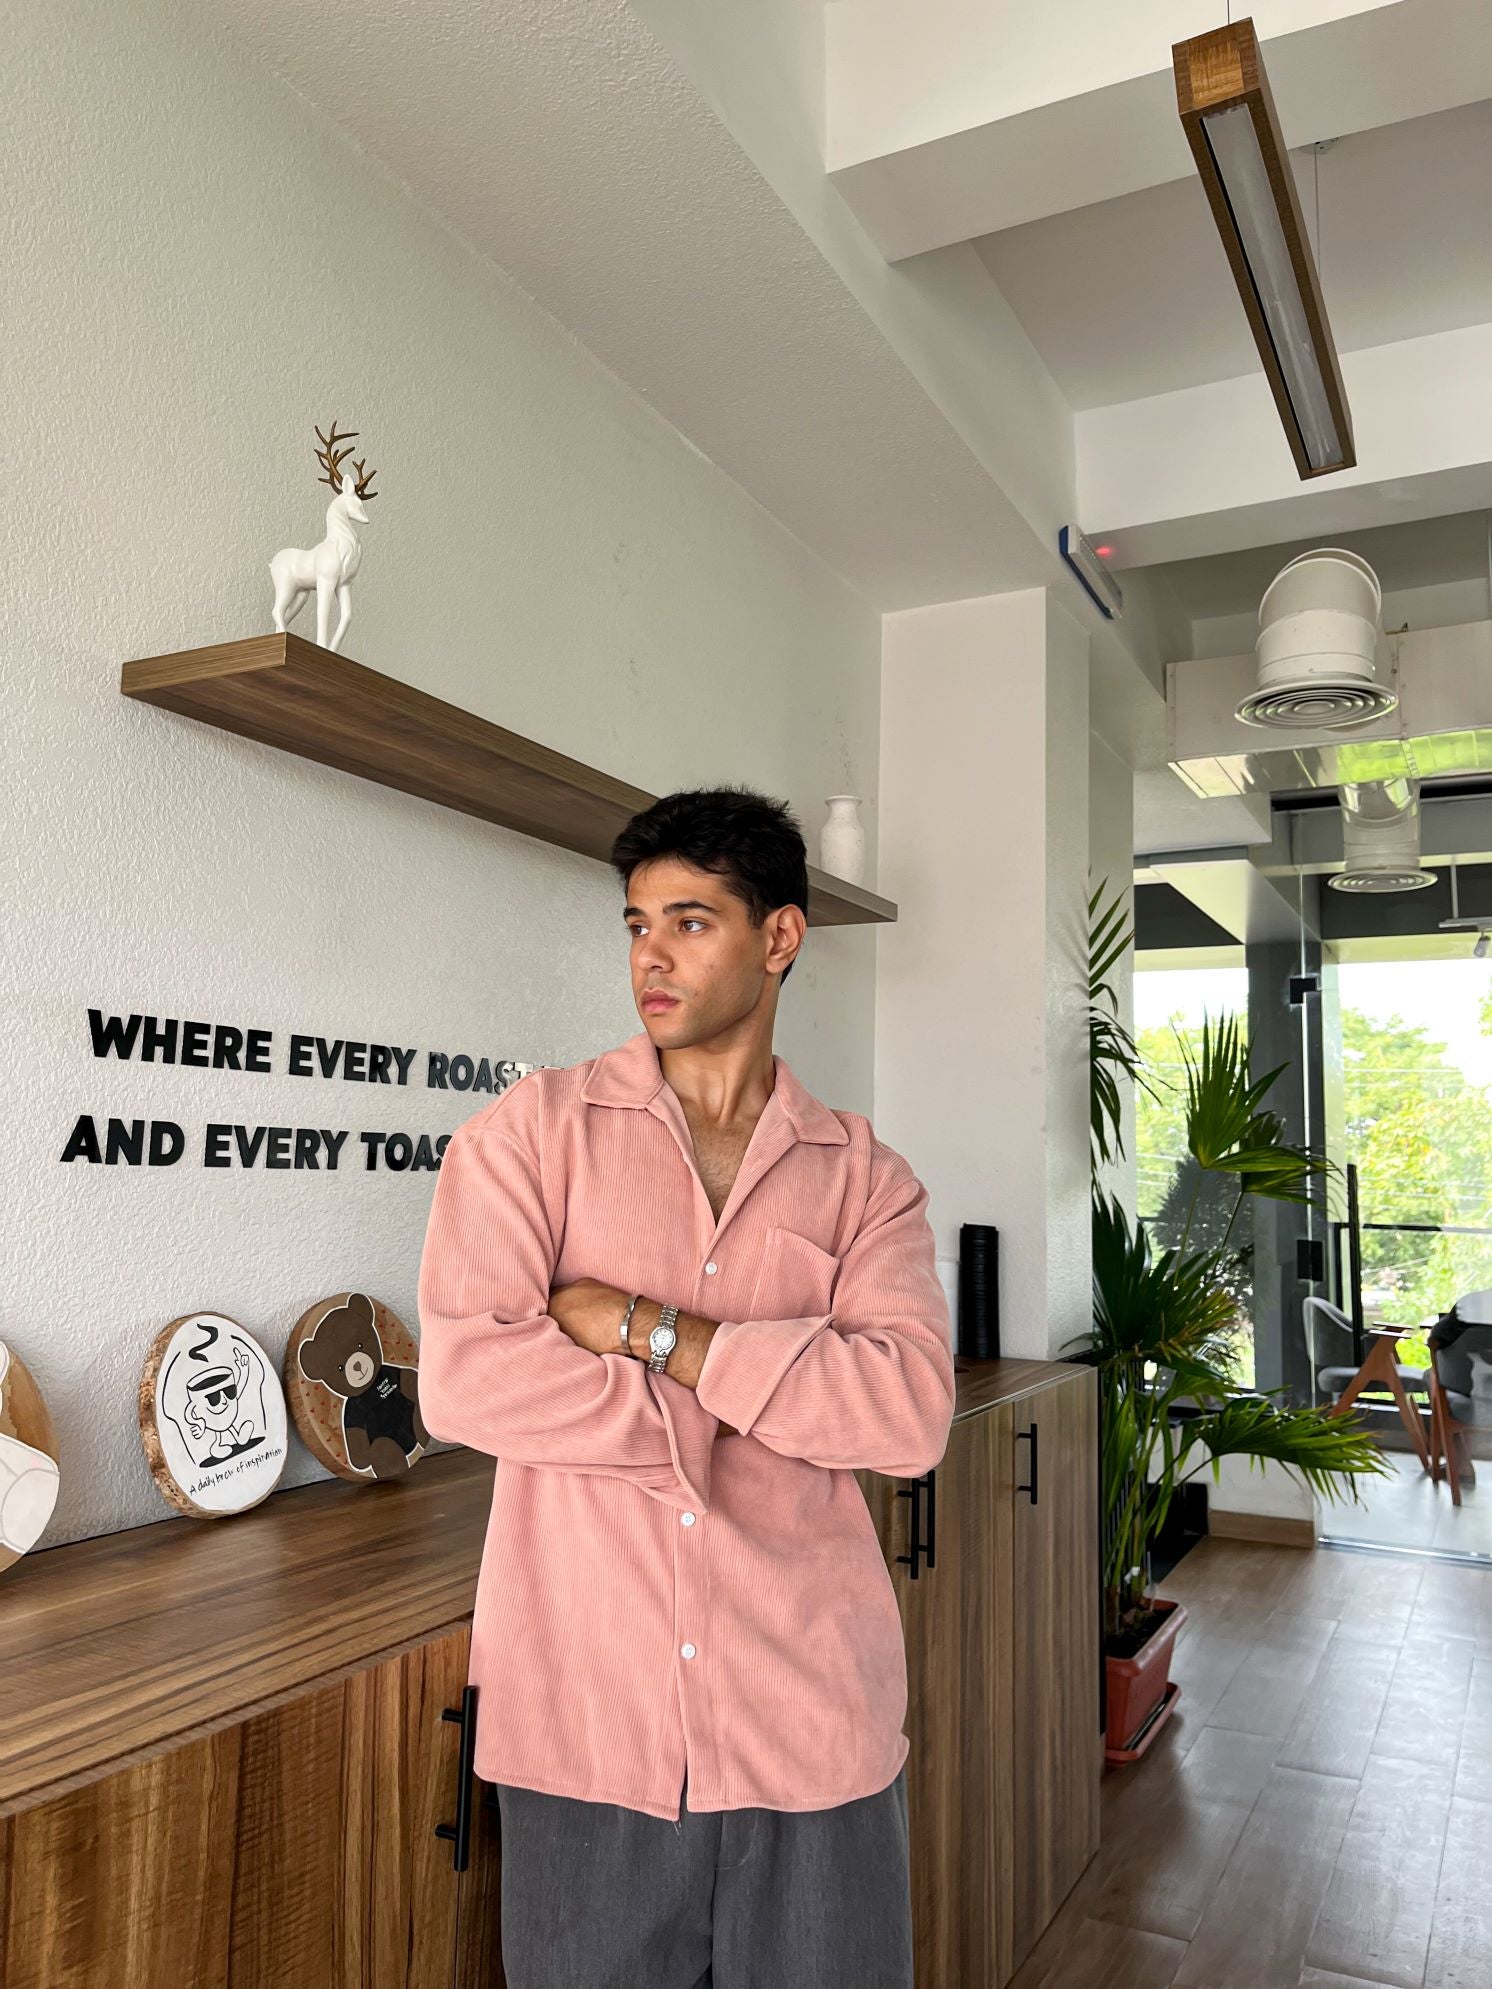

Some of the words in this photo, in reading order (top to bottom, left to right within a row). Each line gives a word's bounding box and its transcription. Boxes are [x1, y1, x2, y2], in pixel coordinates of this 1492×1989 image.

[87, 1008, 272, 1072] WHERE
[288, 1034, 417, 1086] EVERY
[60, 1115, 185, 1166] AND
[204, 1123, 349, 1170] EVERY
[189, 1484, 197, 1496] A
[198, 1475, 216, 1492] daily
[236, 1461, 244, 1473] of
[244, 1448, 283, 1469] inspiration
